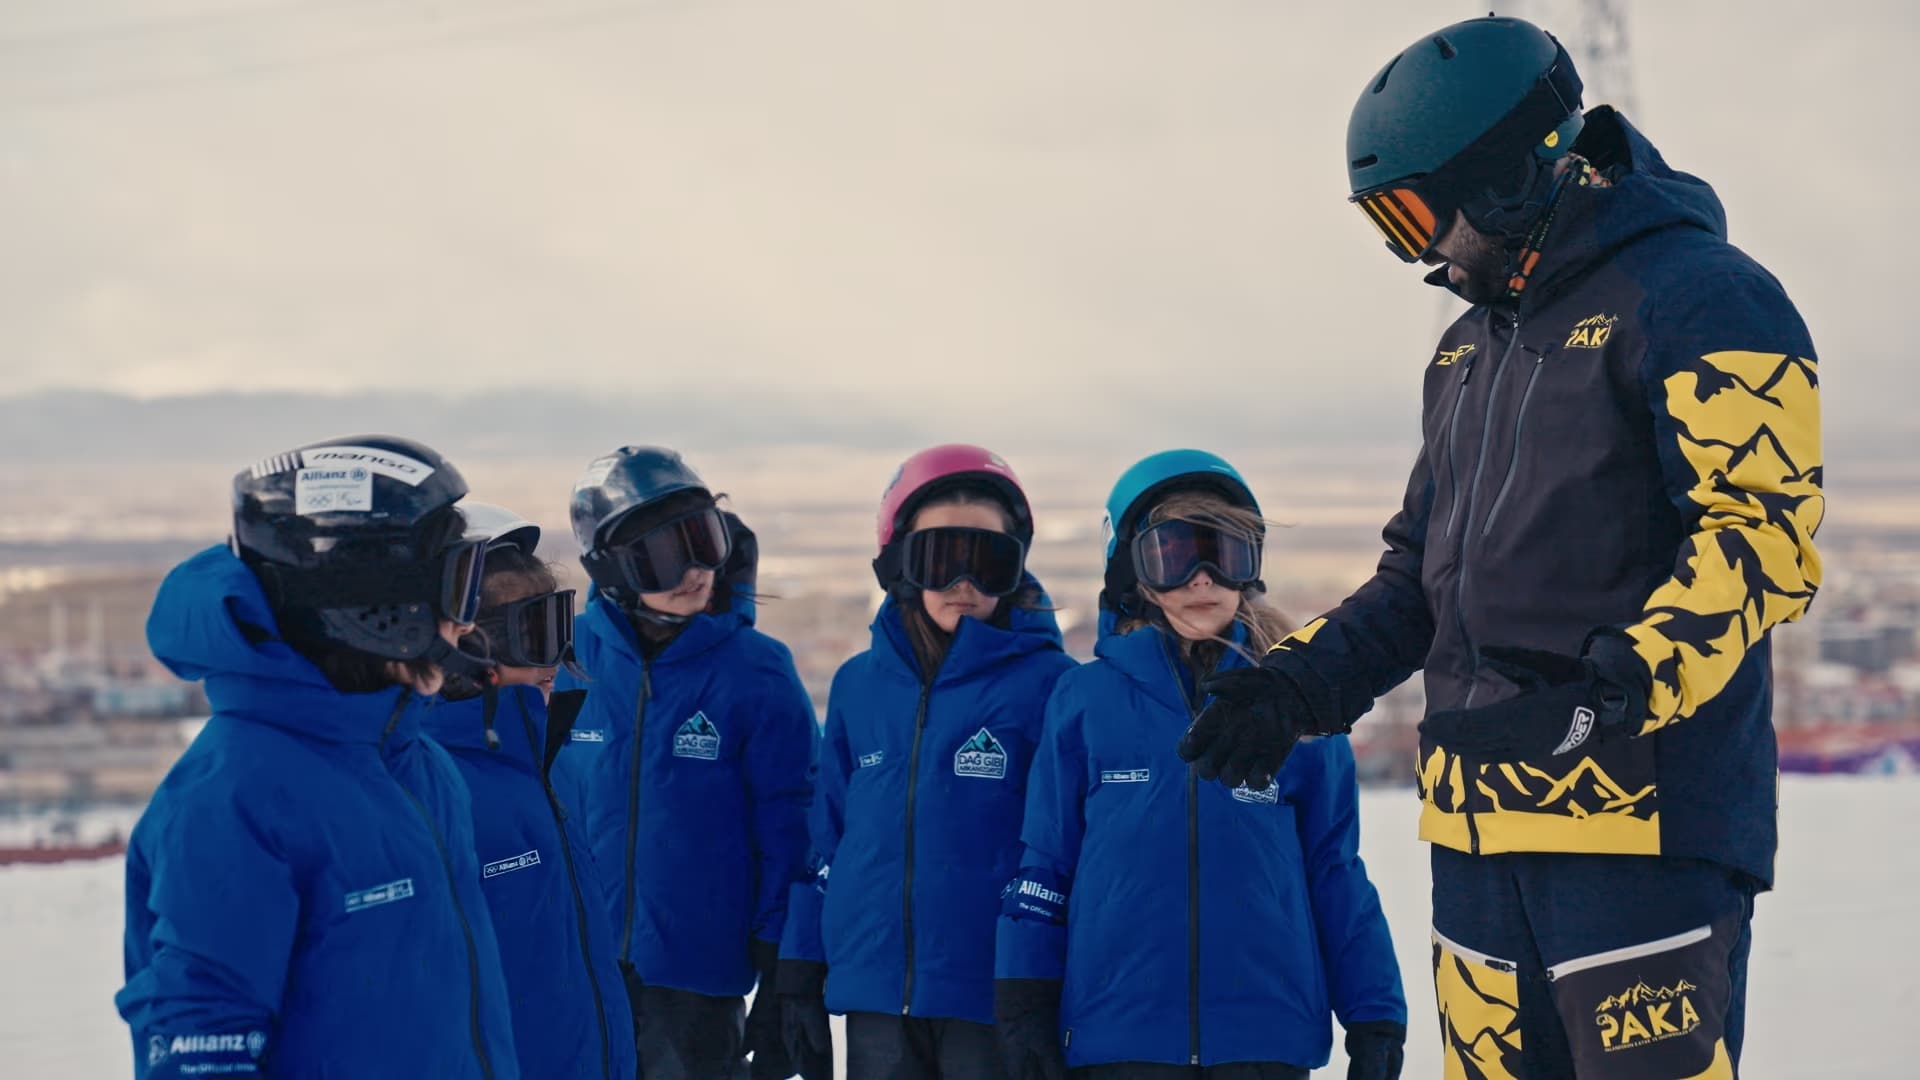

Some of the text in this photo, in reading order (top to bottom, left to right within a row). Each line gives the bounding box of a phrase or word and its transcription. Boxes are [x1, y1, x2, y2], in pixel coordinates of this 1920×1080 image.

[301, 471, 347, 481] Allianz
[959, 753, 982, 766] DAĞ
[1018, 879, 1065, 904] Allianz
[1596, 995, 1700, 1048] PAKA
[170, 1034, 245, 1054] Allianz
